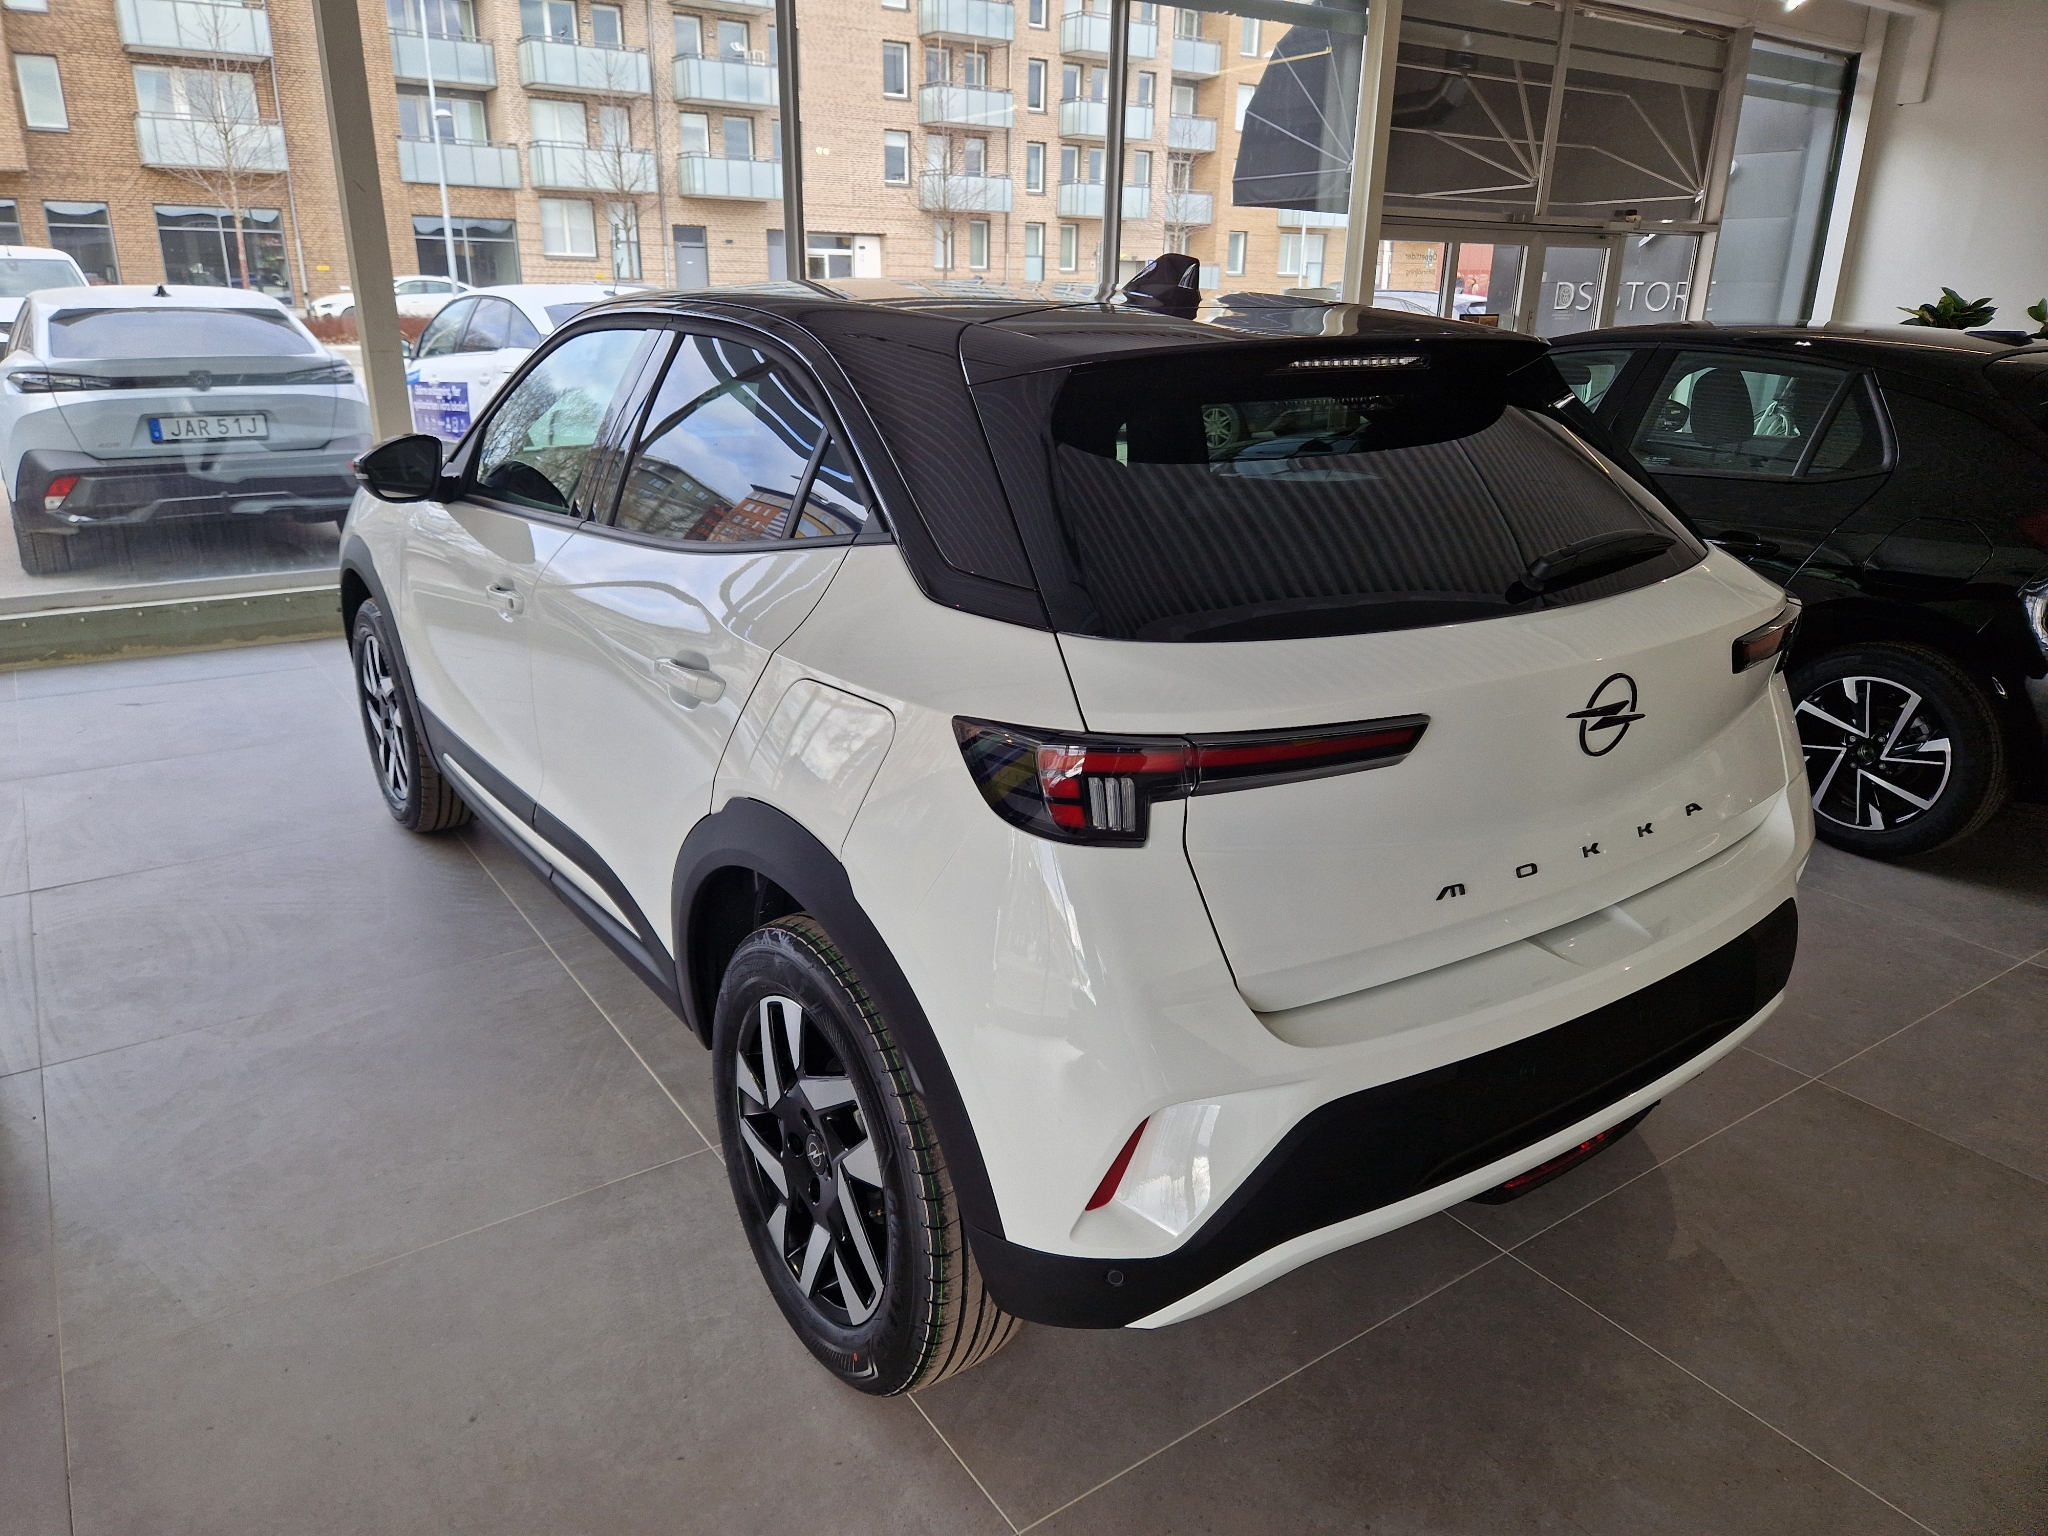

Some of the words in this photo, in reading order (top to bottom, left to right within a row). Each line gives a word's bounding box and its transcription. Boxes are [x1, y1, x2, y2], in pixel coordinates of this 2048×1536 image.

[1553, 281, 1594, 311] DS
[1616, 281, 1717, 312] TOR
[171, 418, 212, 437] JAR
[217, 417, 259, 435] 51J
[1435, 802, 1703, 901] MOKKA
